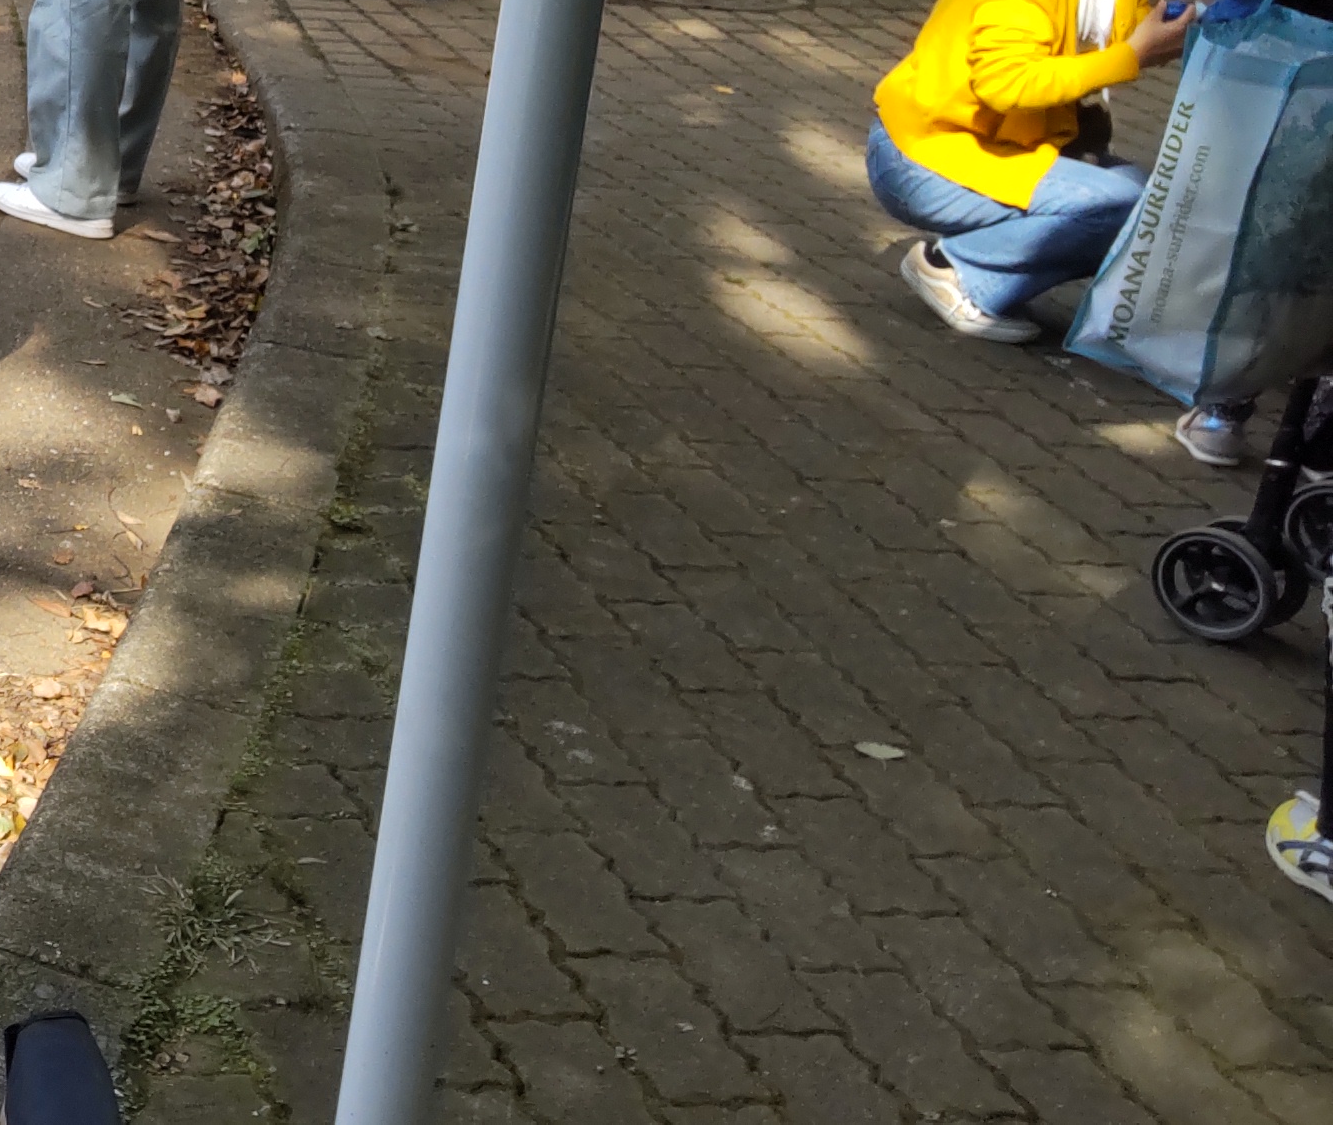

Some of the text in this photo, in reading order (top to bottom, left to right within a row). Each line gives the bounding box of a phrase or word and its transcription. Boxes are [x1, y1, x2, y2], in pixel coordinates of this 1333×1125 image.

[1107, 101, 1195, 348] MOANA SURFRIDER
[1150, 144, 1210, 323] moana-surfrider.com
